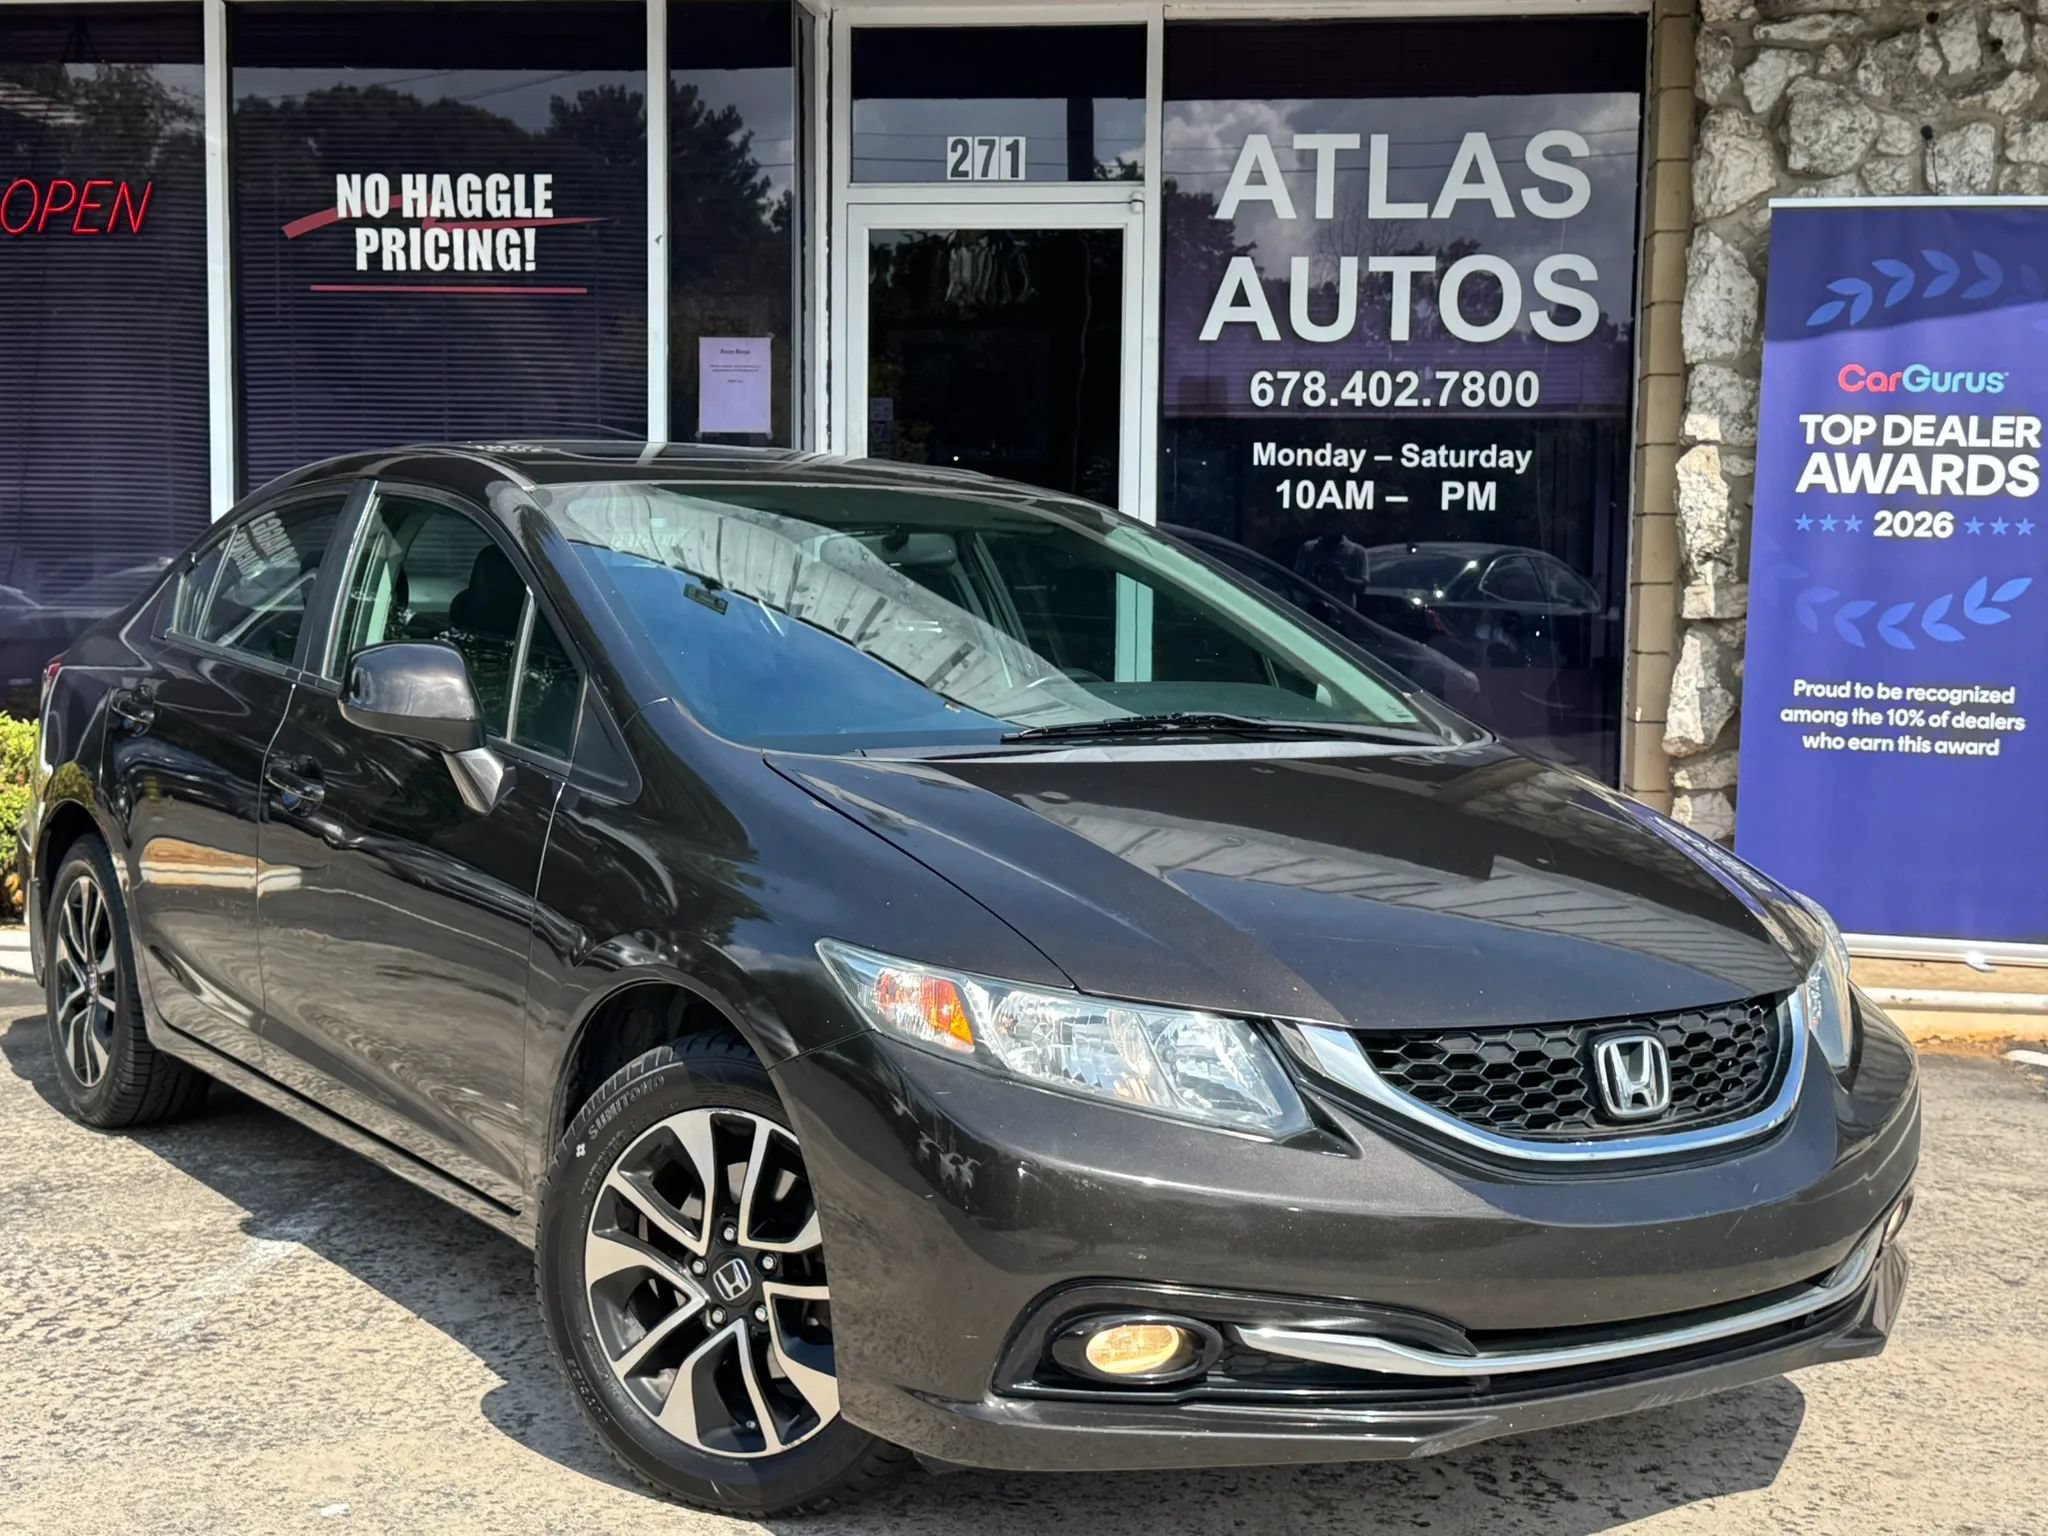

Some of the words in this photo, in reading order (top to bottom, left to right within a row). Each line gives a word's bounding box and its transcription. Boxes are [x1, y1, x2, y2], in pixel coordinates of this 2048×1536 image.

[949, 138, 1020, 179] 271
[1215, 131, 1590, 219] ATLAS
[0, 179, 151, 234] OPEN
[337, 174, 389, 218] NO
[402, 174, 553, 217] HAGGLE
[356, 228, 535, 271] PRICING!
[1200, 255, 1598, 341] AUTOS
[1251, 371, 1538, 407] 678.402.7800
[1838, 363, 2006, 393] CarGurus
[1800, 414, 1876, 445] TOP
[1883, 415, 2041, 447] DEALER
[1254, 442, 1366, 473] Monday
[1401, 444, 1532, 474] Saturday
[1796, 453, 2039, 497] AWARDS
[1277, 480, 1374, 509] 10AM
[1442, 481, 1496, 510] PM
[1874, 511, 1953, 538] 2026
[1794, 679, 1851, 698] Proud
[1854, 683, 1874, 699] to
[1877, 682, 1903, 700] be
[1906, 686, 2015, 705] recognized
[1781, 709, 1848, 727] among
[1852, 707, 1883, 725] the
[1887, 709, 1926, 727] 10%
[1928, 710, 1951, 727] of
[1951, 711, 2025, 731] dealers
[1803, 732, 1845, 749] who
[1848, 737, 1894, 751] earn
[1897, 735, 1931, 753] this
[1934, 739, 2000, 756] award
